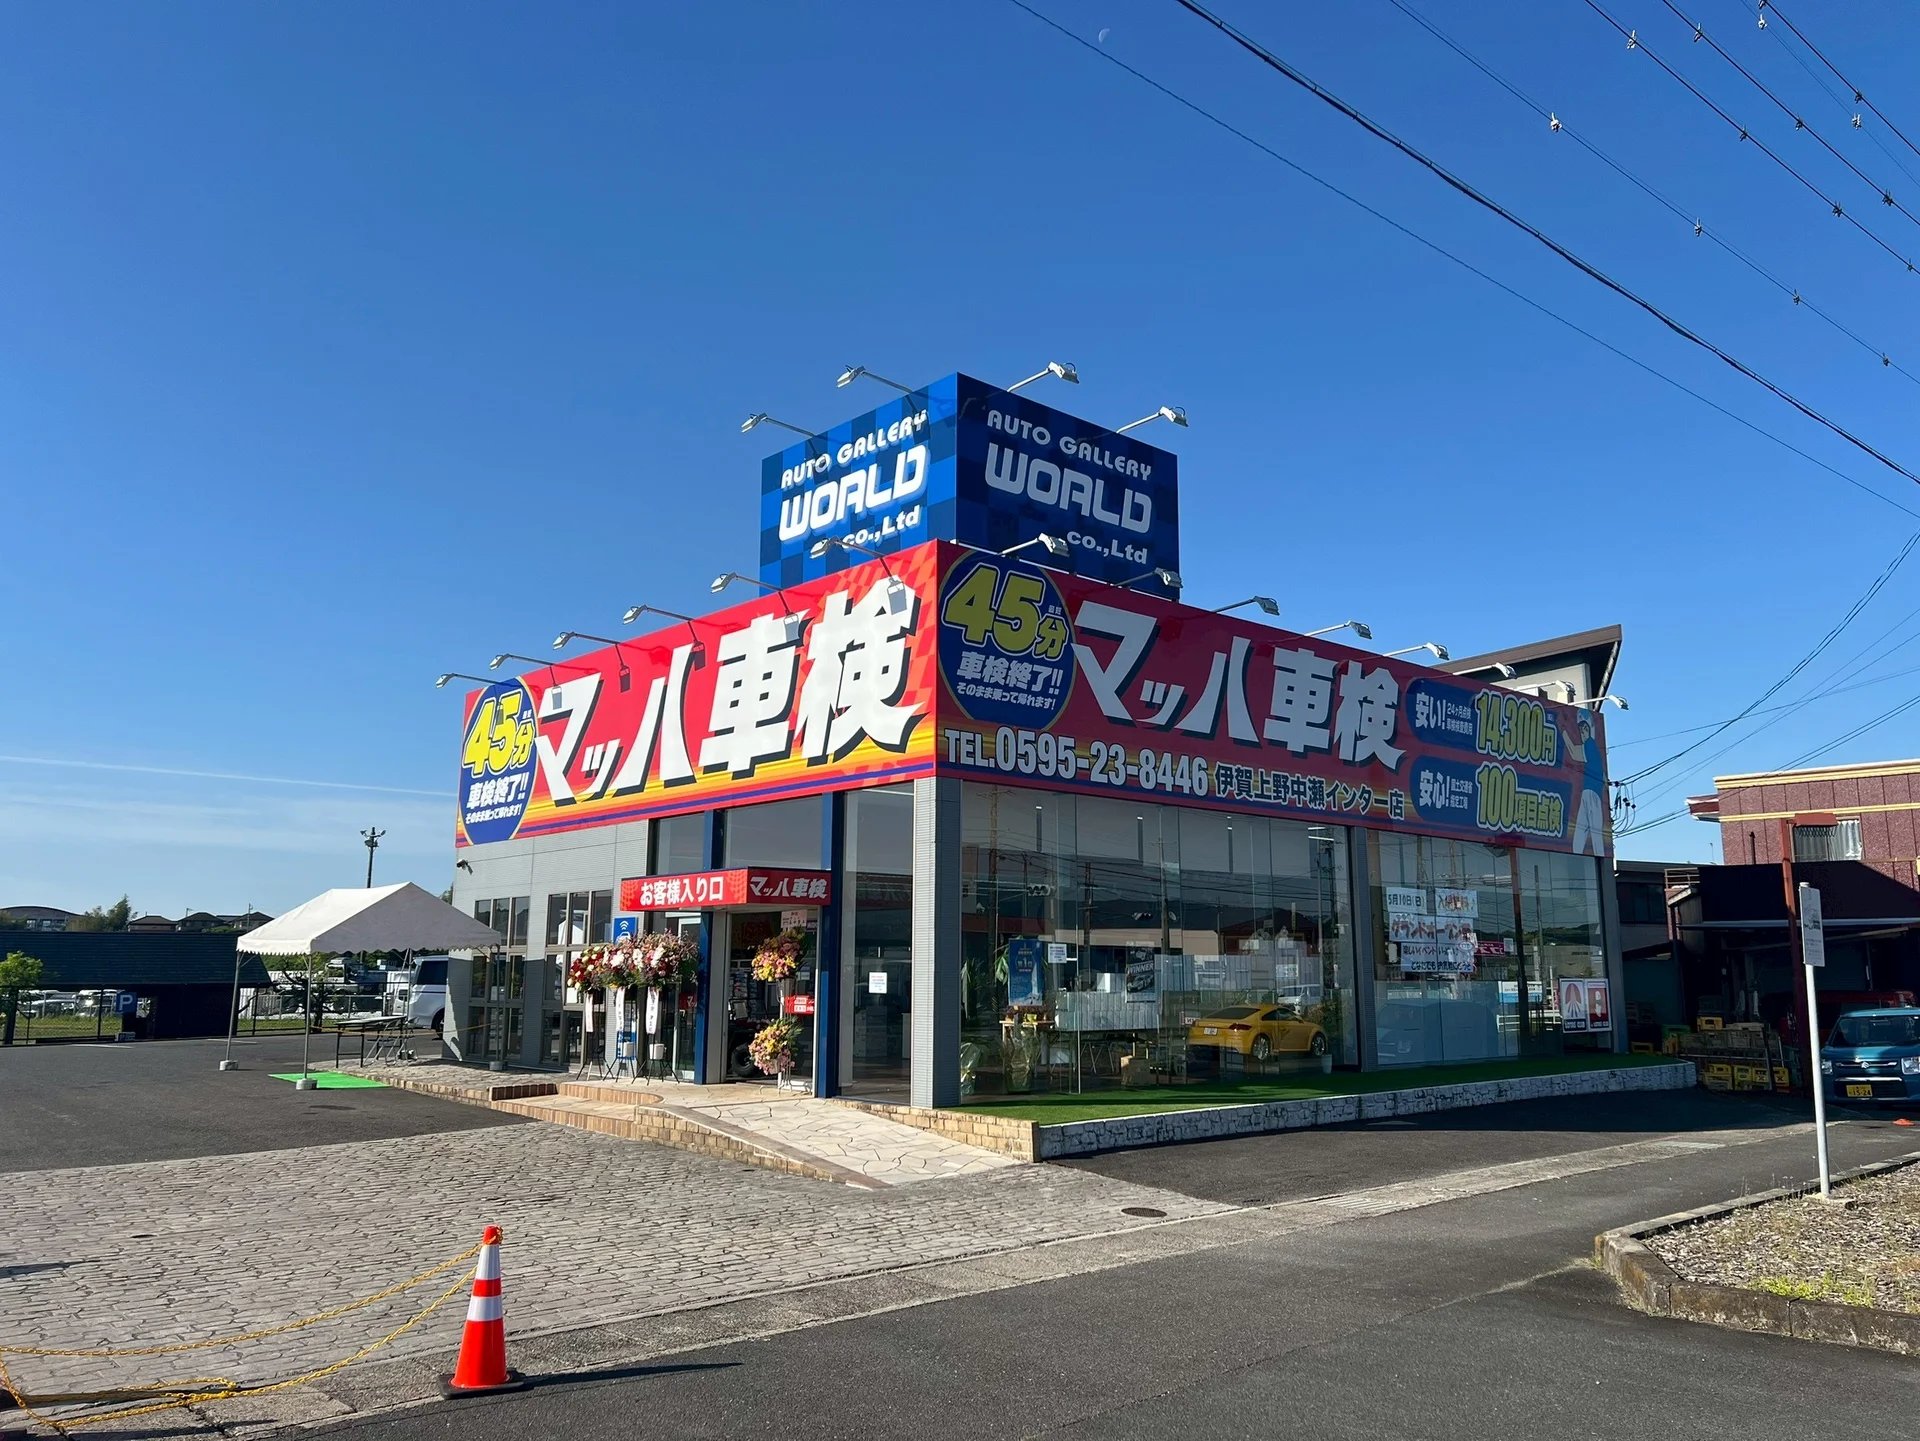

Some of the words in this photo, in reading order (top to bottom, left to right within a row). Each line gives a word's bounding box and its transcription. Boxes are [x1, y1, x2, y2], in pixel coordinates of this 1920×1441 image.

[780, 452, 829, 489] AUTO
[836, 408, 927, 462] GALLERY
[987, 409, 1051, 446] AUTO
[1058, 435, 1152, 481] GALLERY
[778, 443, 929, 542] WORLD
[984, 442, 1153, 534] WORLD
[1066, 530, 1148, 565] co.,Ltd
[942, 564, 1068, 661] 45分
[534, 574, 928, 806] マッハ車検
[1070, 600, 1407, 770] マッハ車検
[462, 689, 535, 778] 45分
[1214, 762, 1406, 822] 伊賀上野中瀬インター店
[639, 876, 725, 907] お客様入り口
[750, 876, 828, 899] マッハ車検
[119, 994, 133, 1011] P
